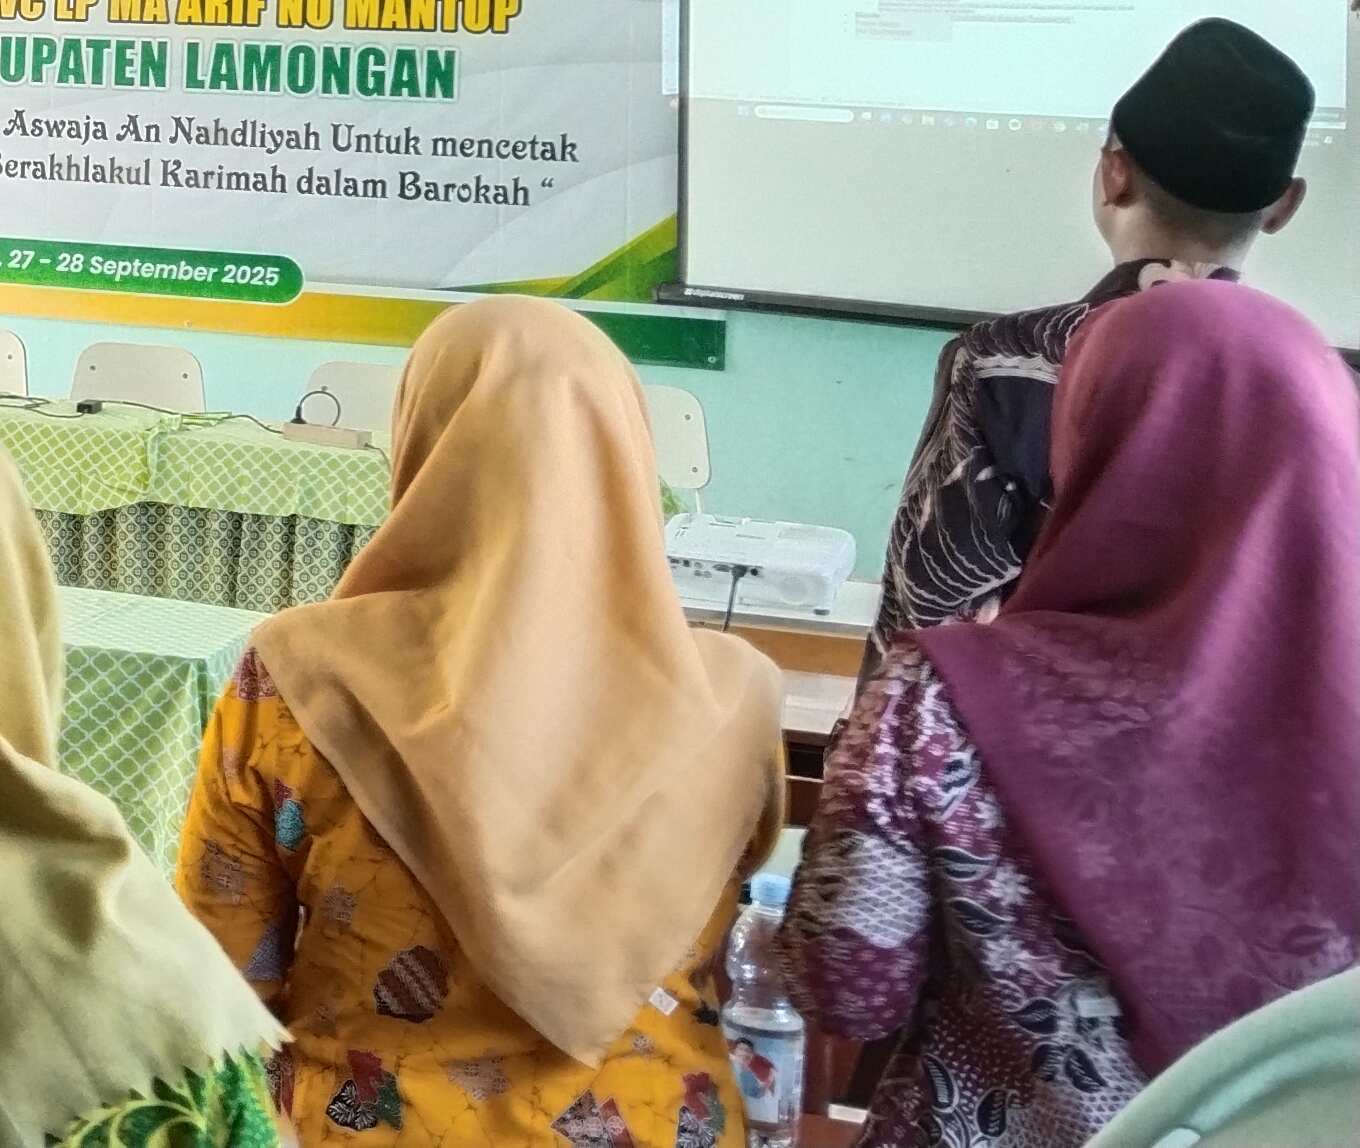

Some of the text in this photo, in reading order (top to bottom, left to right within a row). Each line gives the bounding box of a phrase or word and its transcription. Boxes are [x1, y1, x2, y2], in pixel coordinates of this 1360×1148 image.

[184, 42, 458, 100] LAMONGAN
[2, 109, 109, 144] Aswaja
[115, 113, 162, 144] An
[168, 115, 322, 154] Nahdliyah
[330, 122, 423, 157] Untuk
[430, 131, 579, 163] mencetak
[158, 157, 289, 194] Karimah
[295, 165, 389, 199] dalam
[396, 170, 530, 207] Barokah
[8, 249, 35, 271] 27
[56, 252, 85, 274] 28
[89, 255, 218, 285] September
[221, 263, 280, 288] 2025
